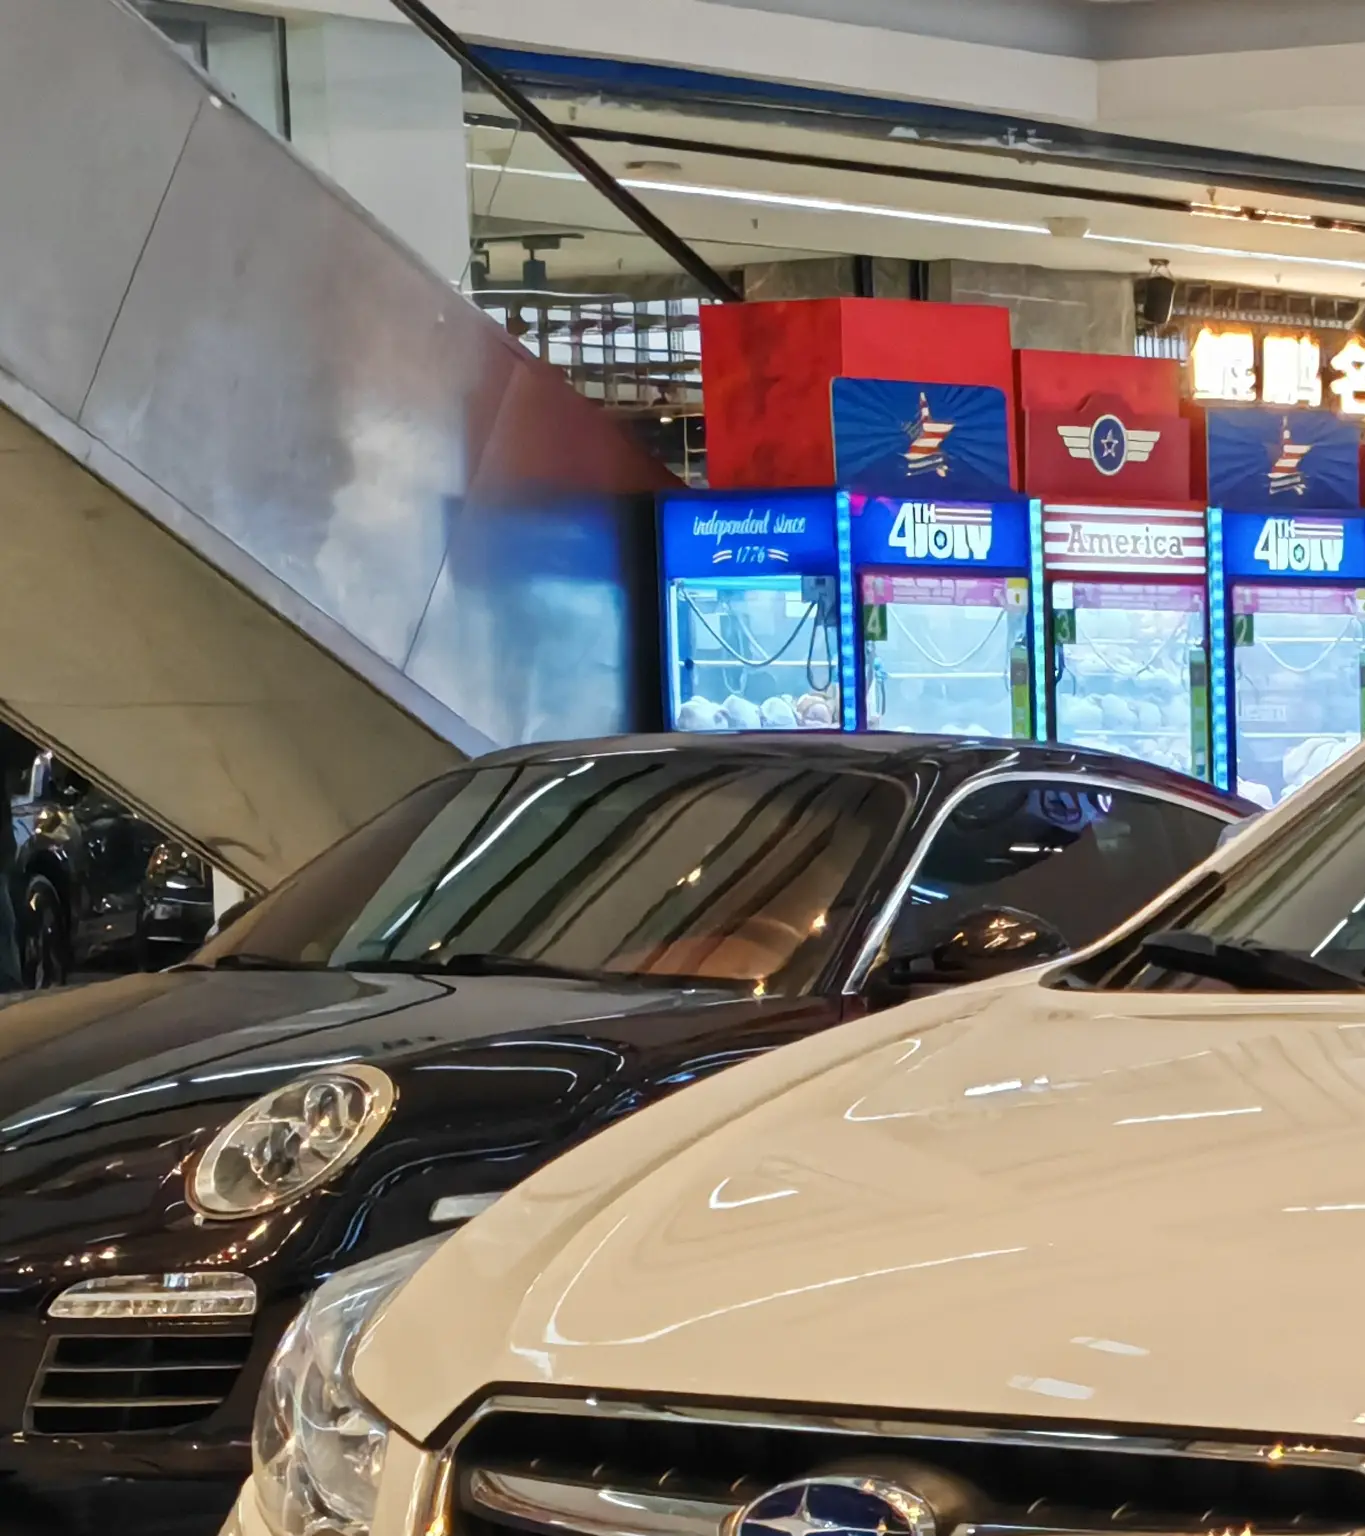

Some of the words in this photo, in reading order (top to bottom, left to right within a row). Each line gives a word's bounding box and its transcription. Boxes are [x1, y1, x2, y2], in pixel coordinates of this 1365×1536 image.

[773, 514, 806, 533] since
[1067, 523, 1183, 557] America
[735, 546, 765, 563] 1776
[867, 605, 882, 635] 4
